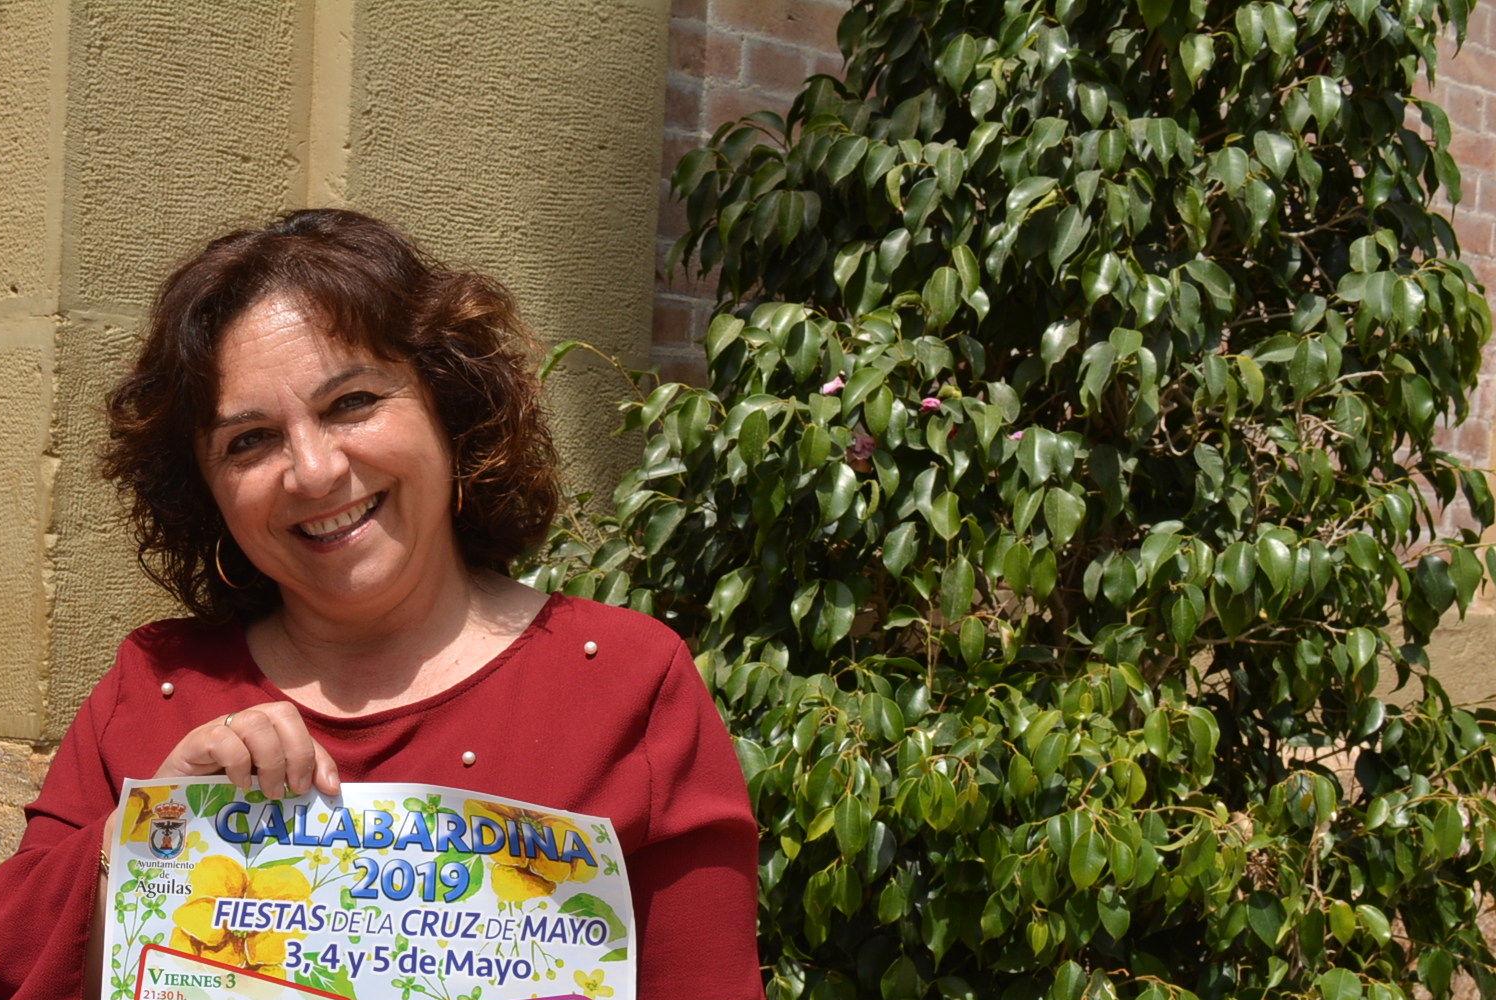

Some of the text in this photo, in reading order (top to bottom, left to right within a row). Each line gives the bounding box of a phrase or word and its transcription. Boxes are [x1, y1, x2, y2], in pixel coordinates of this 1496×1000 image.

[215, 801, 597, 866] CALABARDINA
[136, 860, 194, 870] Ayuntamiento
[159, 871, 169, 879] de
[350, 858, 470, 902] 2019
[135, 877, 192, 896] Águilas
[214, 900, 606, 946] FIESTAS DE LA CRUZ DE MAYO
[286, 941, 531, 985] 3, 4 y 5 de Mayo
[226, 974, 236, 988] 3
